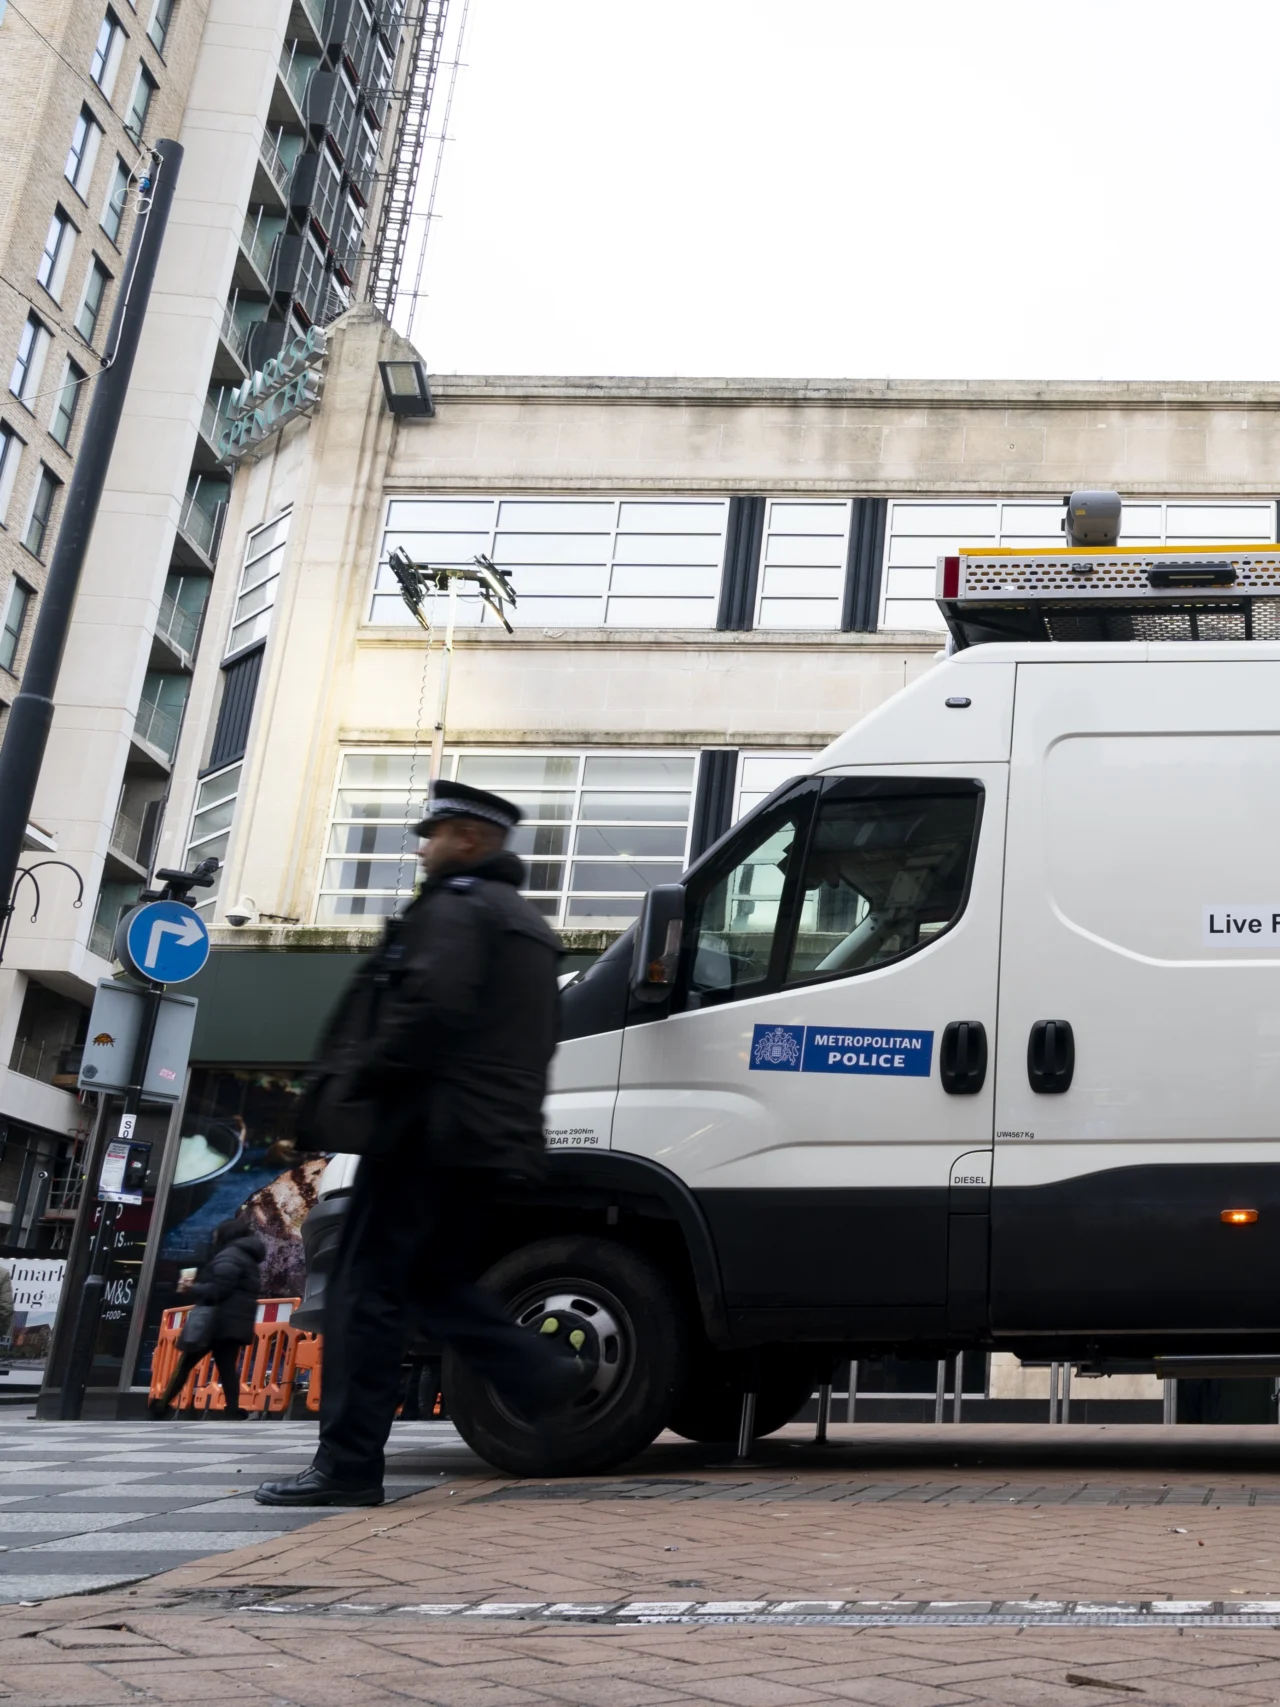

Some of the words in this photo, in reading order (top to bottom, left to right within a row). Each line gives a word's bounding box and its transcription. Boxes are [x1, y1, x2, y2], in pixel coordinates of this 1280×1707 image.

[1208, 913, 1263, 934] Live
[814, 1034, 922, 1050] METROPOLITAN
[827, 1052, 906, 1068] POLICE
[544, 1128, 568, 1136] Torque
[549, 1137, 569, 1145] BAR
[571, 1137, 582, 1145] 70
[583, 1136, 599, 1145] PSI
[953, 1176, 987, 1184] DIESEL
[104, 1278, 133, 1306] M&S
